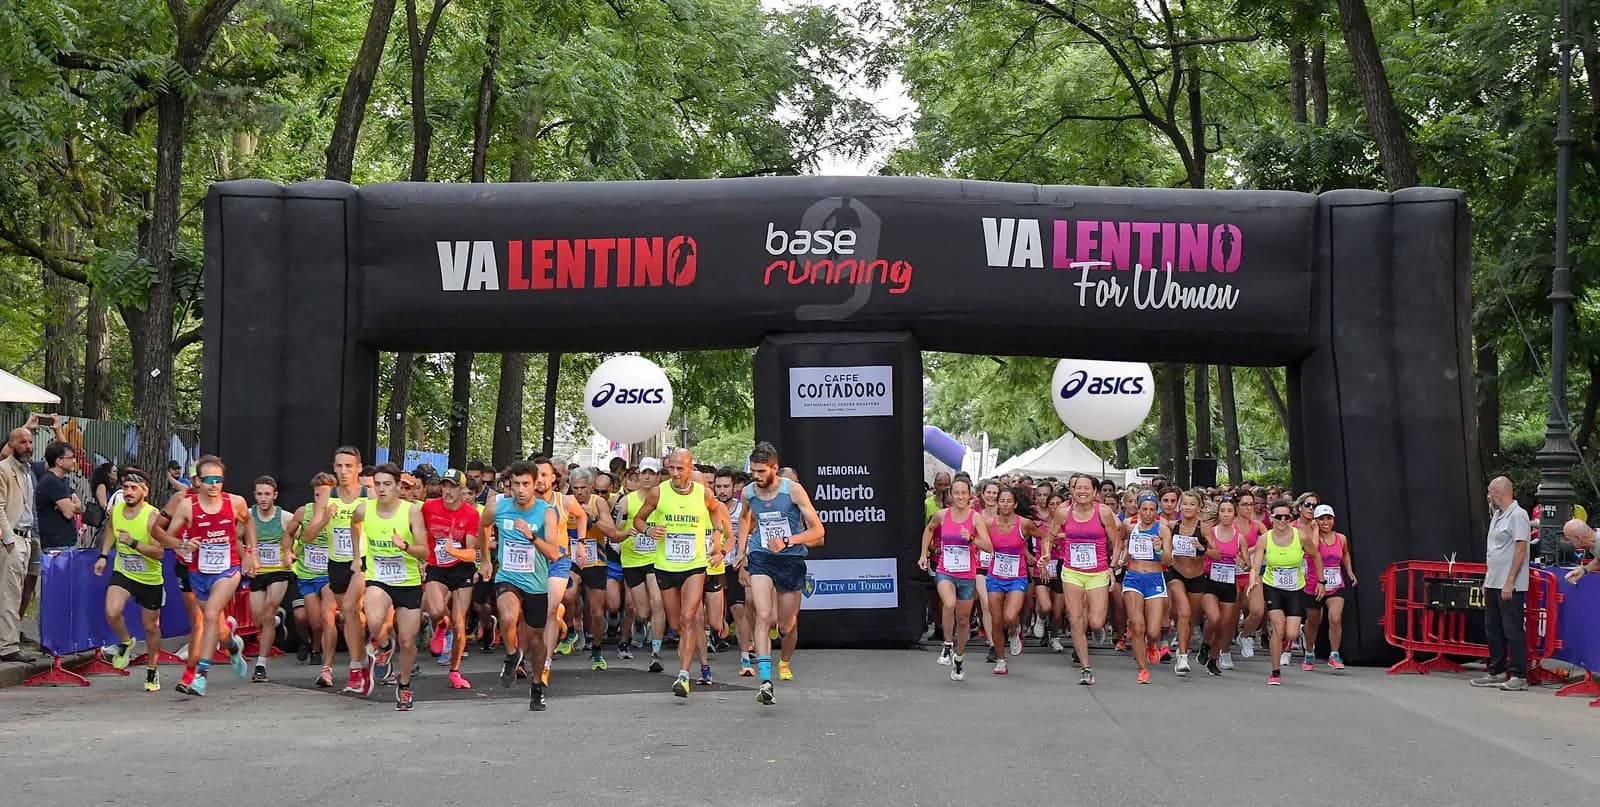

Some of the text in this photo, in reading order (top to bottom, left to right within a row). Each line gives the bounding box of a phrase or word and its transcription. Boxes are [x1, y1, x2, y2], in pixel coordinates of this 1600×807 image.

[765, 222, 857, 256] base
[982, 217, 1243, 273] VA LENTINO
[436, 235, 698, 291] VA LENTINO
[763, 259, 913, 294] running
[1069, 261, 1240, 310] For Women
[797, 382, 886, 399] COSTADORO
[1087, 376, 1144, 395] asics
[615, 388, 664, 405] asics
[817, 465, 870, 476] MEMORIAL
[814, 483, 875, 501] Alberto
[816, 506, 886, 523] ombetta
[638, 537, 655, 546] 1423
[671, 544, 690, 555] 1518
[204, 554, 225, 565] 1222
[307, 555, 327, 565] 1498
[509, 553, 529, 564] 1761
[954, 556, 960, 565] 5
[1076, 554, 1091, 563] 493
[380, 564, 402, 576] 2012
[999, 563, 1013, 573] 584
[848, 582, 857, 591] DI
[858, 580, 892, 591] TORINO
